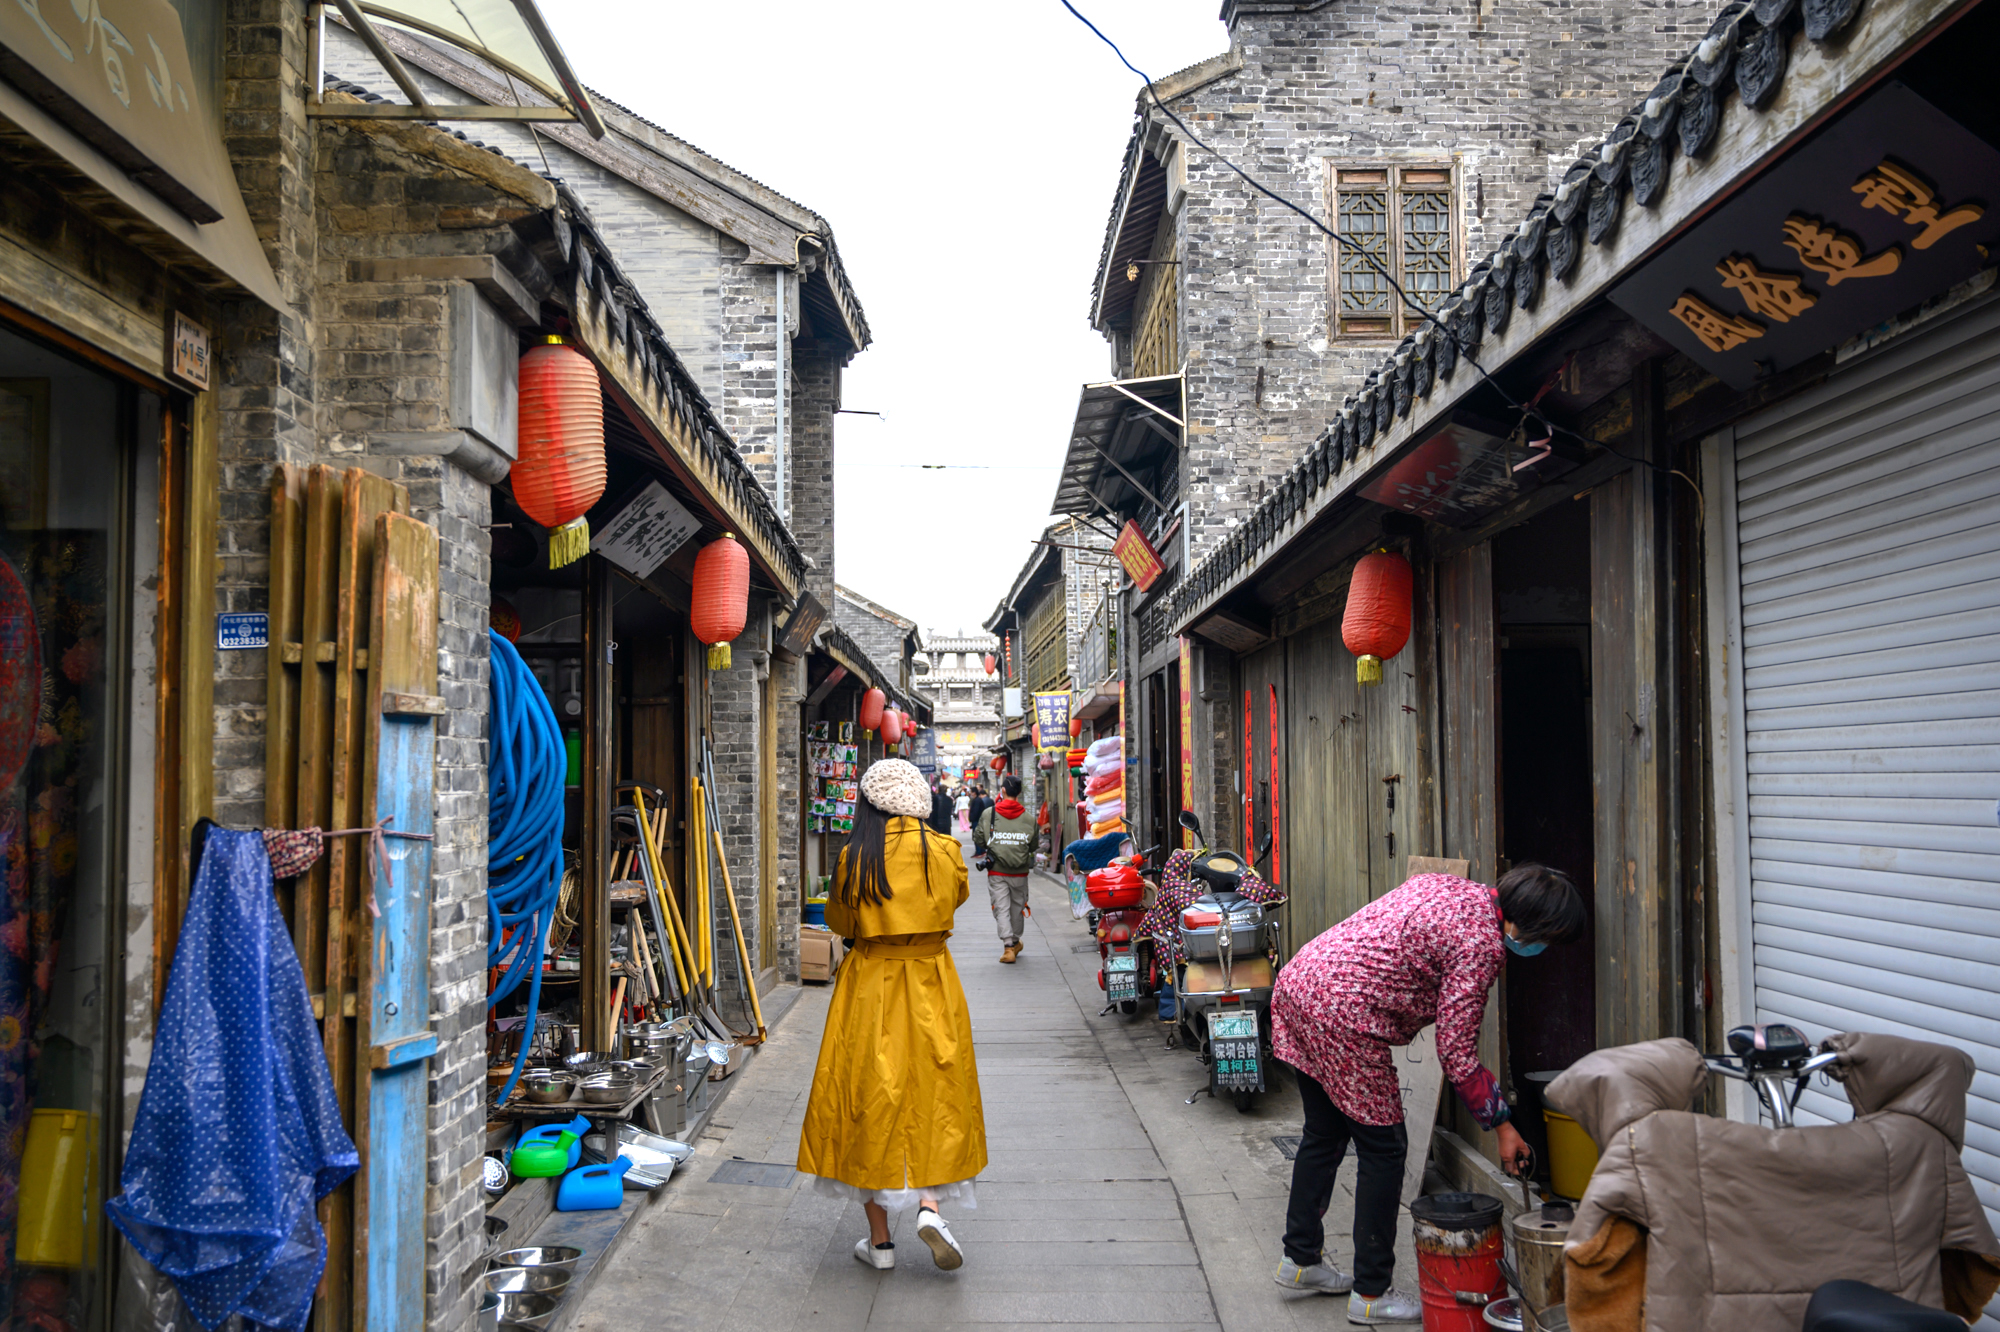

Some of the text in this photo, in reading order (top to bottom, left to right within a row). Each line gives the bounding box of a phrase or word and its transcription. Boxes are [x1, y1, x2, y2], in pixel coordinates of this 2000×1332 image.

[1669, 158, 1985, 352] 風格造型
[180, 338, 205, 368] 41号
[1039, 707, 1068, 726] 寿衣
[1214, 1042, 1257, 1059] 深圳台铃
[1217, 1059, 1258, 1074] 澳柯玛
